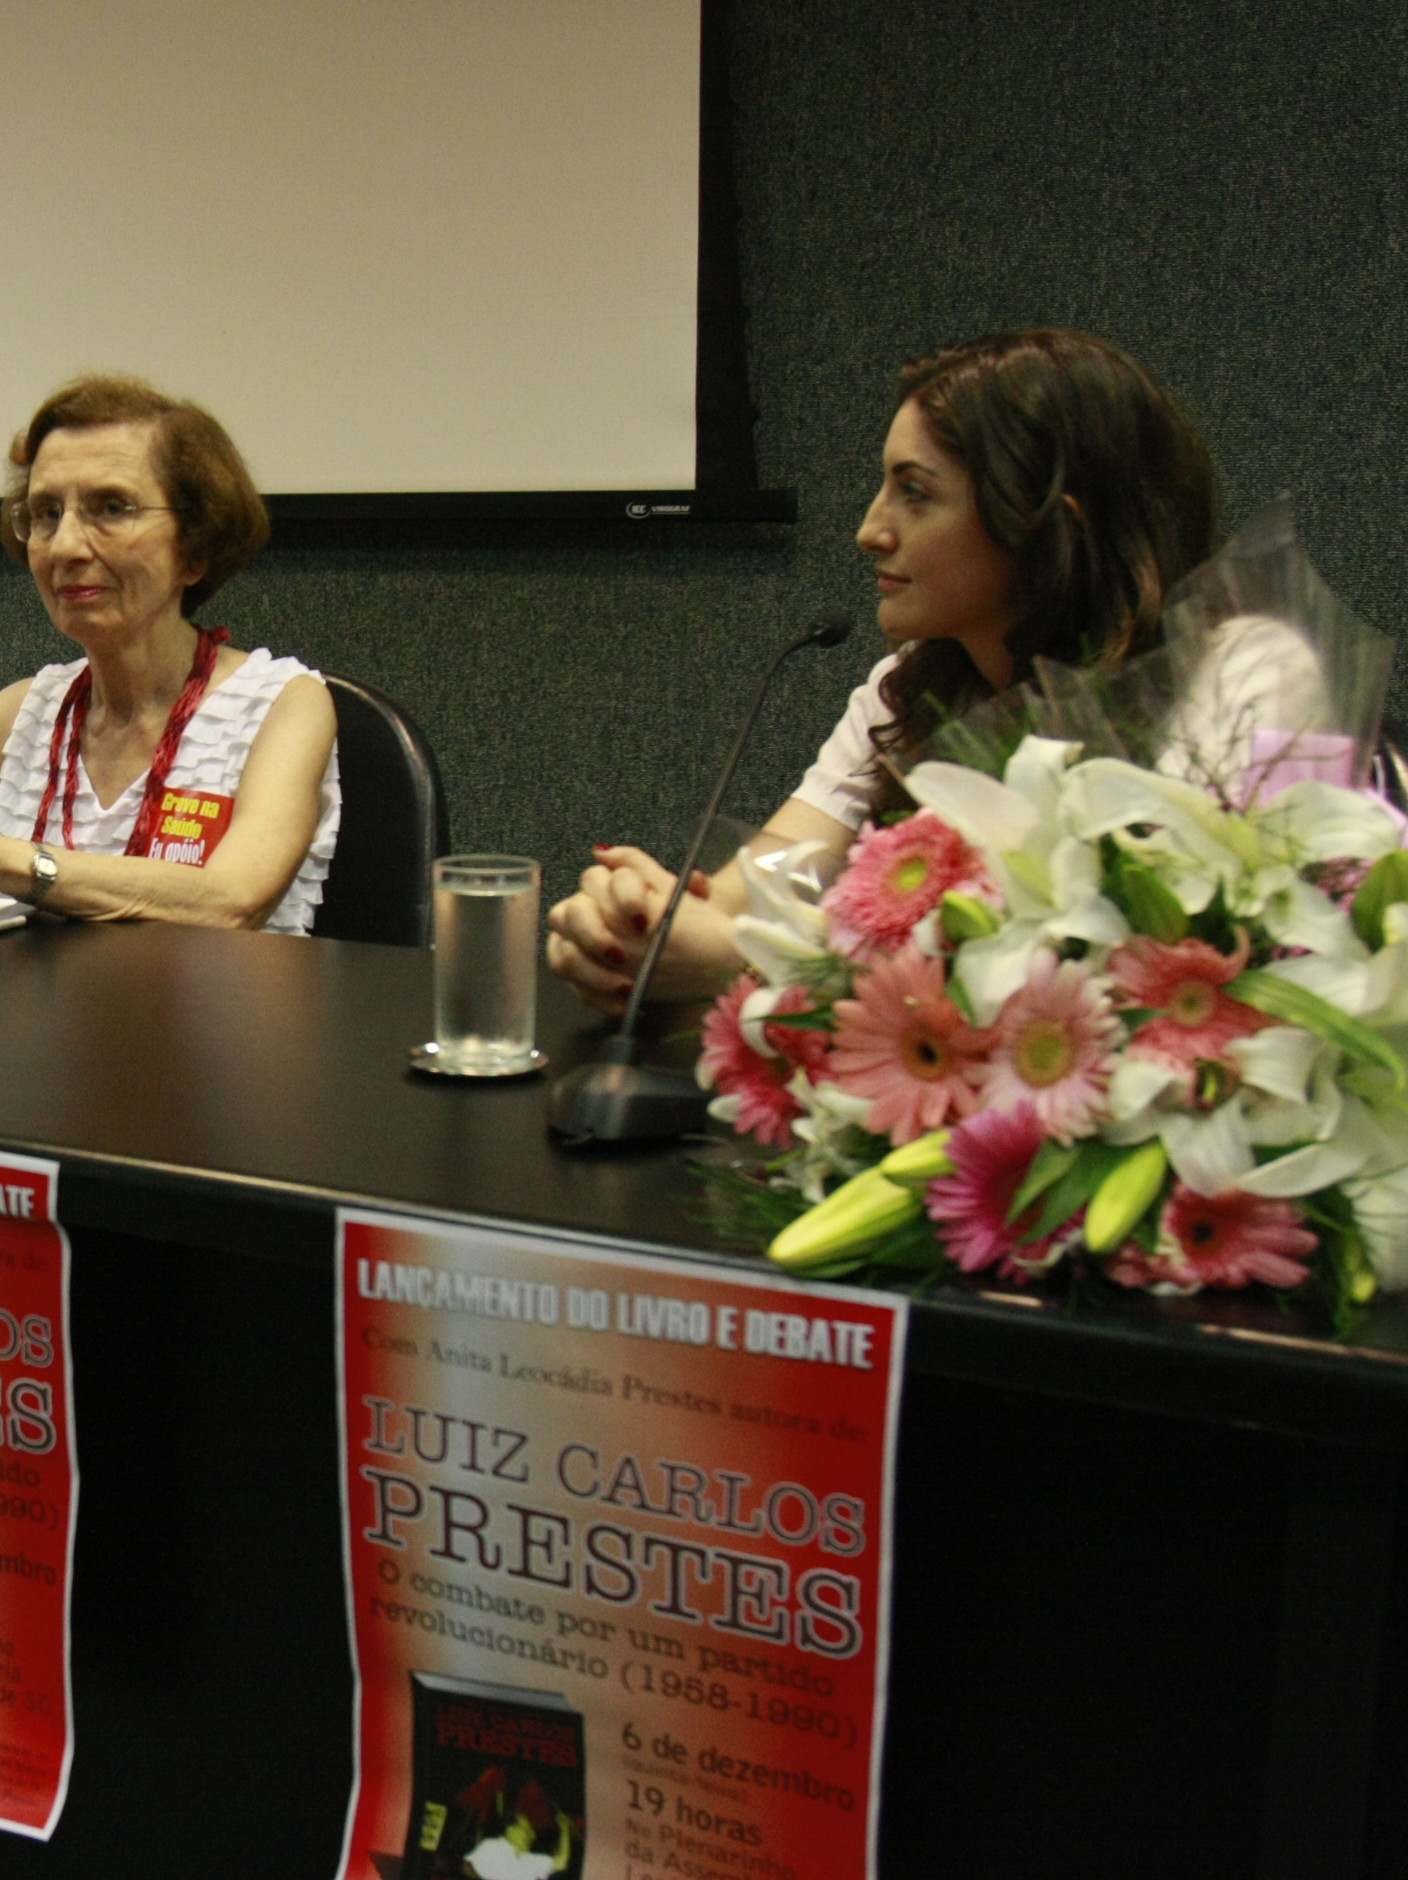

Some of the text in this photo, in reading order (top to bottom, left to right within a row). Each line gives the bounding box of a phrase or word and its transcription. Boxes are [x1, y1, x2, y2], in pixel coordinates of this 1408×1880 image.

[199, 800, 220, 819] na
[357, 1257, 875, 1371] LANÇAMENTO DO LIVRO E DEBATE
[427, 1336, 493, 1372] Anita
[499, 1353, 613, 1398] Leocádia
[622, 1373, 722, 1416] Prestes
[363, 1397, 866, 1557] LUIZ CARLOS
[360, 1466, 864, 1661] PRESTES
[370, 1600, 609, 1680] revolucionário
[377, 1558, 836, 1699] O combate por um partido
[437, 1723, 579, 1768] PRESTES
[622, 1721, 856, 1812] 6 de dezembro
[628, 1779, 763, 1847] 19 horas
